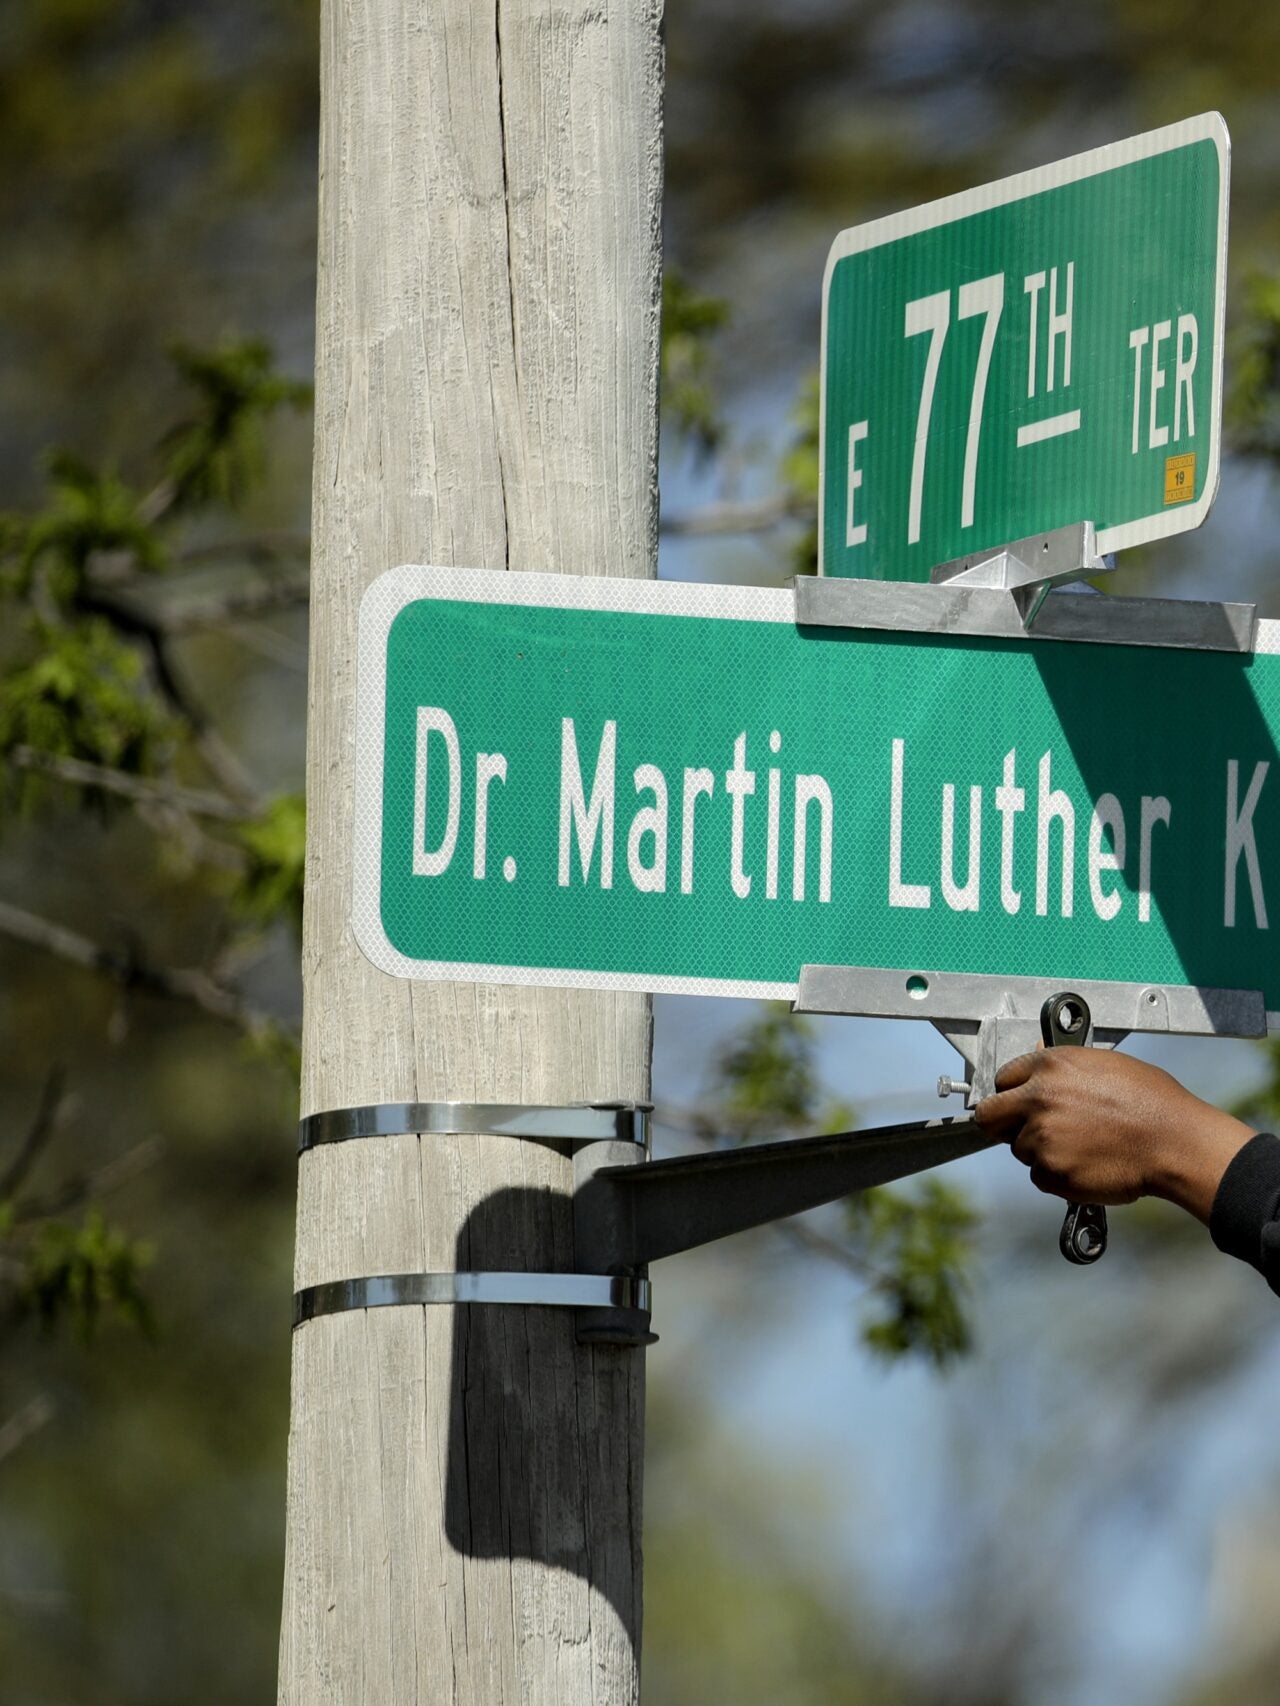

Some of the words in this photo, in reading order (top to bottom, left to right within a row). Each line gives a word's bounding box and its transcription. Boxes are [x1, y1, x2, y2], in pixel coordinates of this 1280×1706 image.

[846, 420, 868, 547] E
[1129, 313, 1199, 454] TER
[1175, 470, 1185, 487] 19
[412, 706, 517, 883] Dr.
[558, 717, 833, 903] Martin
[889, 738, 1172, 923] Luther
